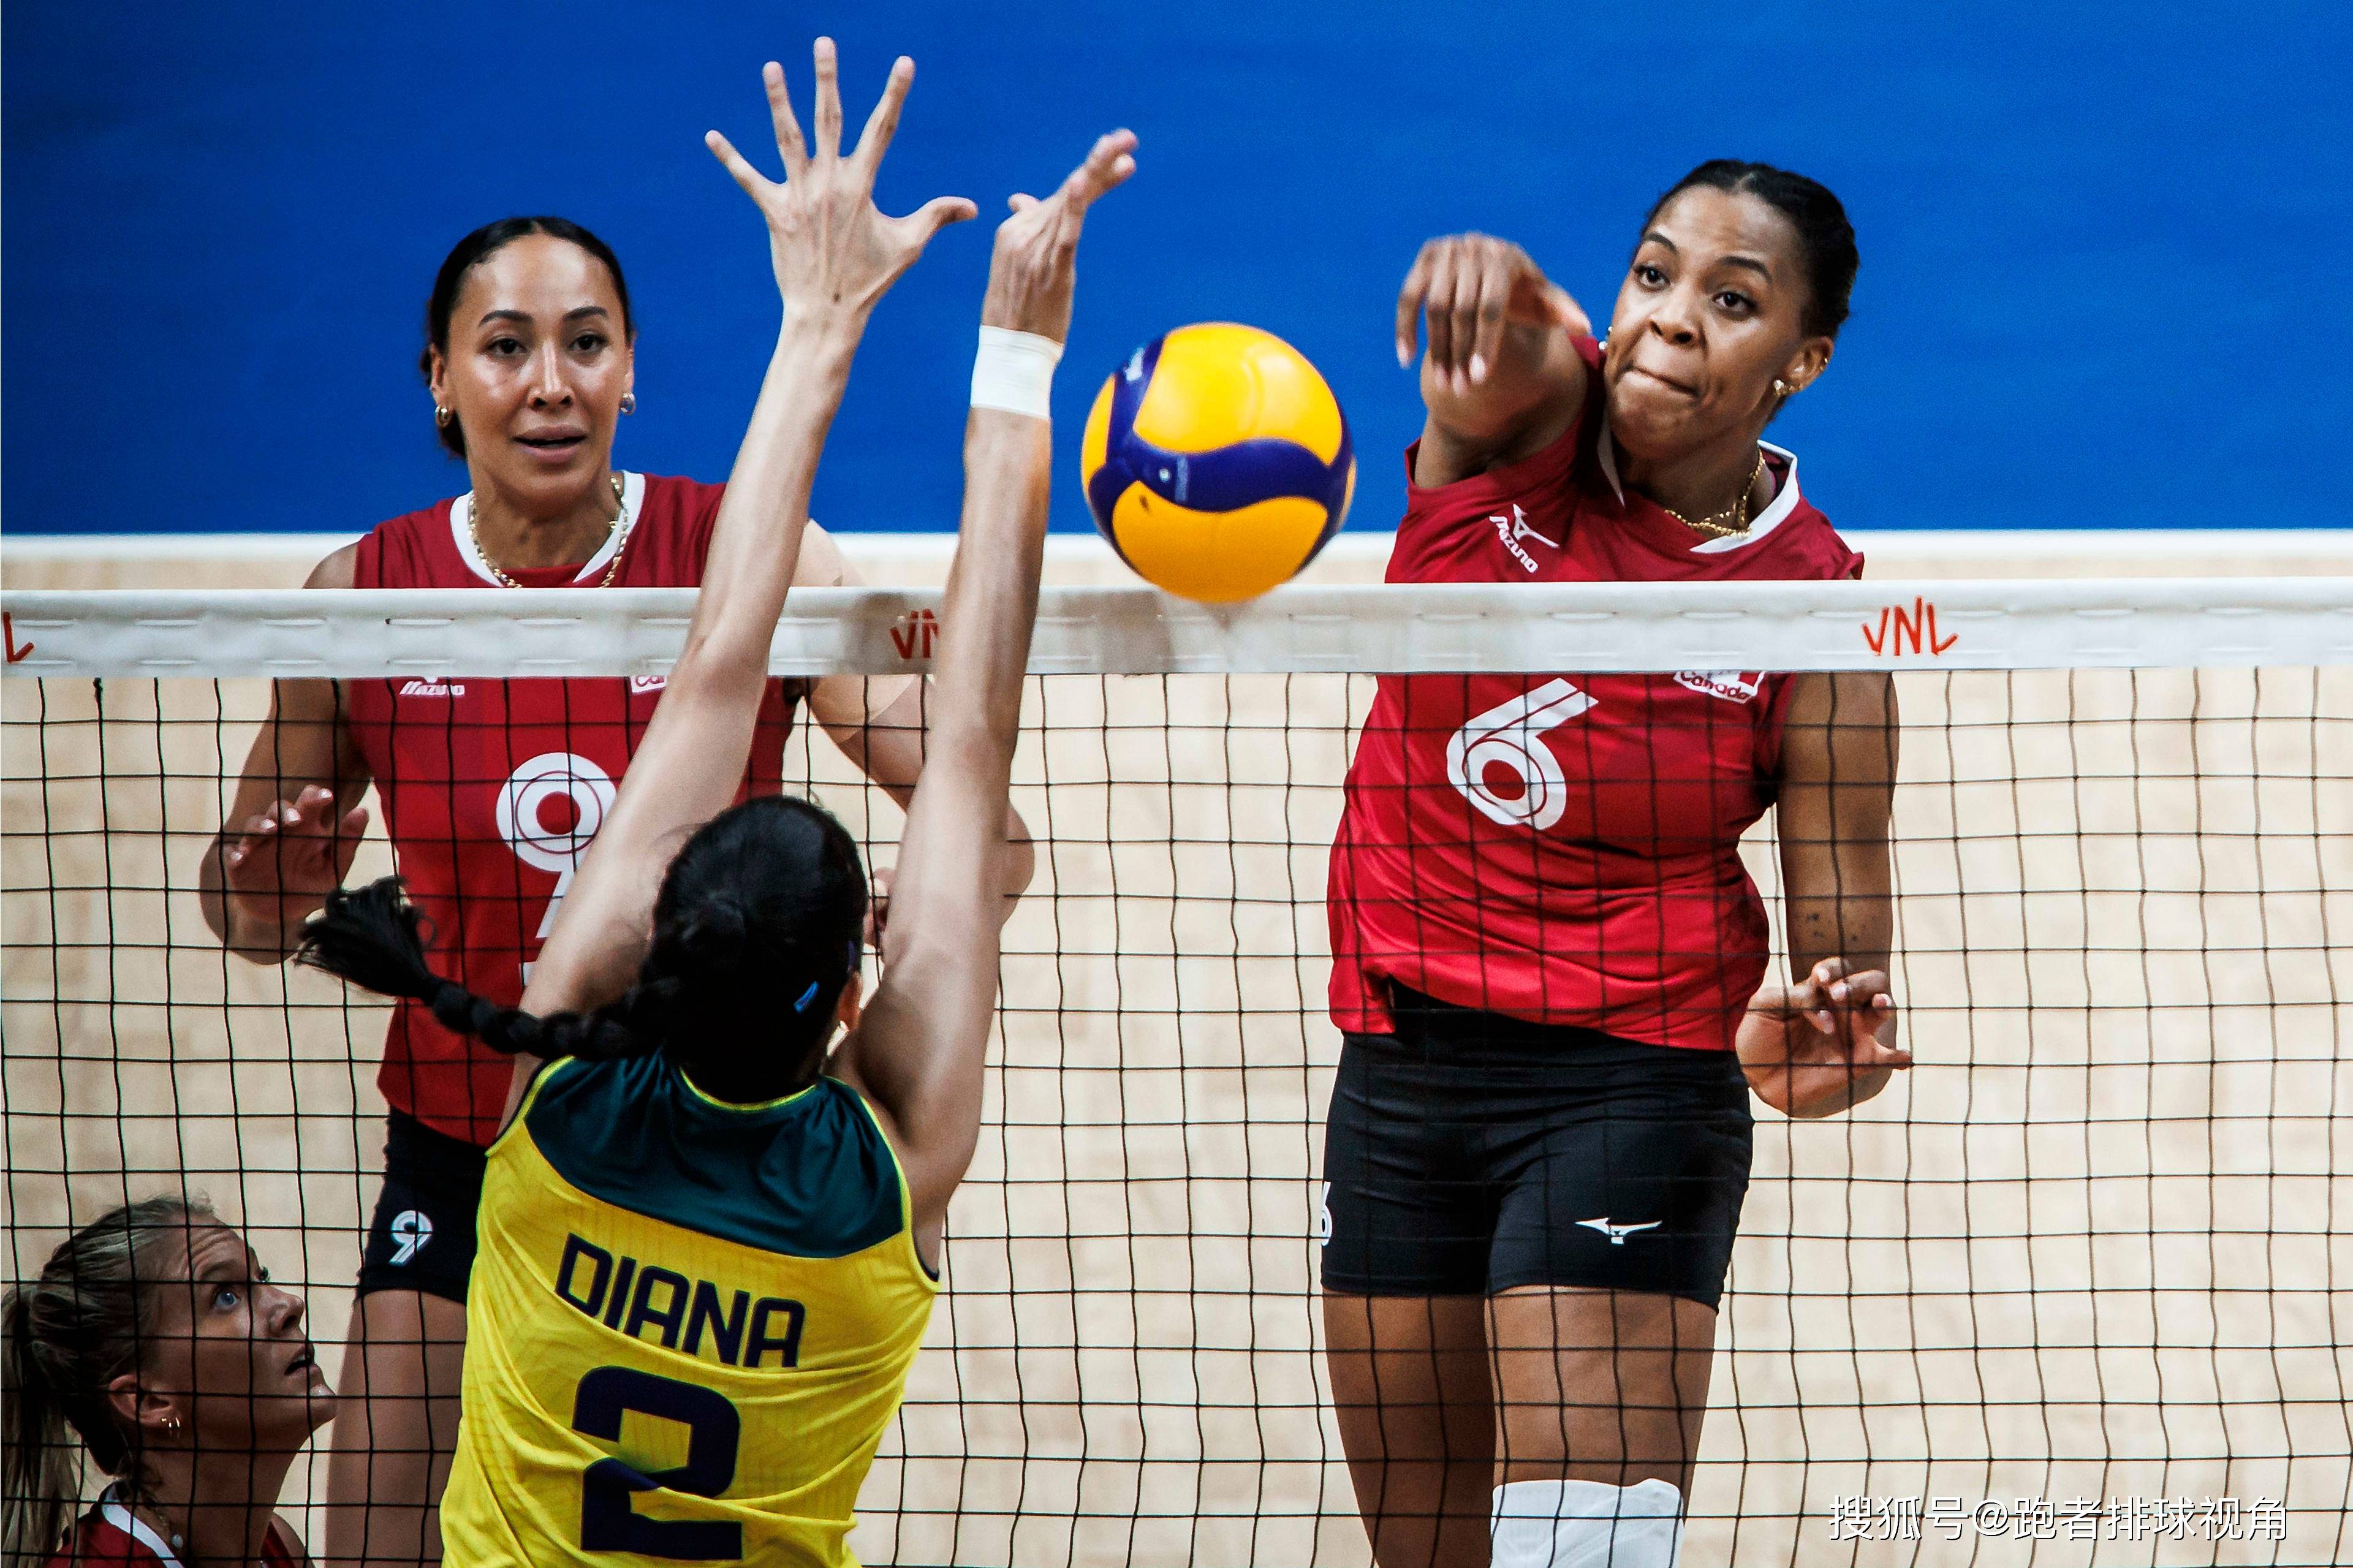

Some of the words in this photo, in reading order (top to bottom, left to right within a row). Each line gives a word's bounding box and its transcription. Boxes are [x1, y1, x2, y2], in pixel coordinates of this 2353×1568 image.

[1862, 596, 1958, 657] VNL
[1446, 678, 1599, 831] 6
[496, 752, 617, 939] 9
[390, 1210, 433, 1265] 9
[555, 1232, 806, 1369] DIANA
[571, 1366, 743, 1561] 2
